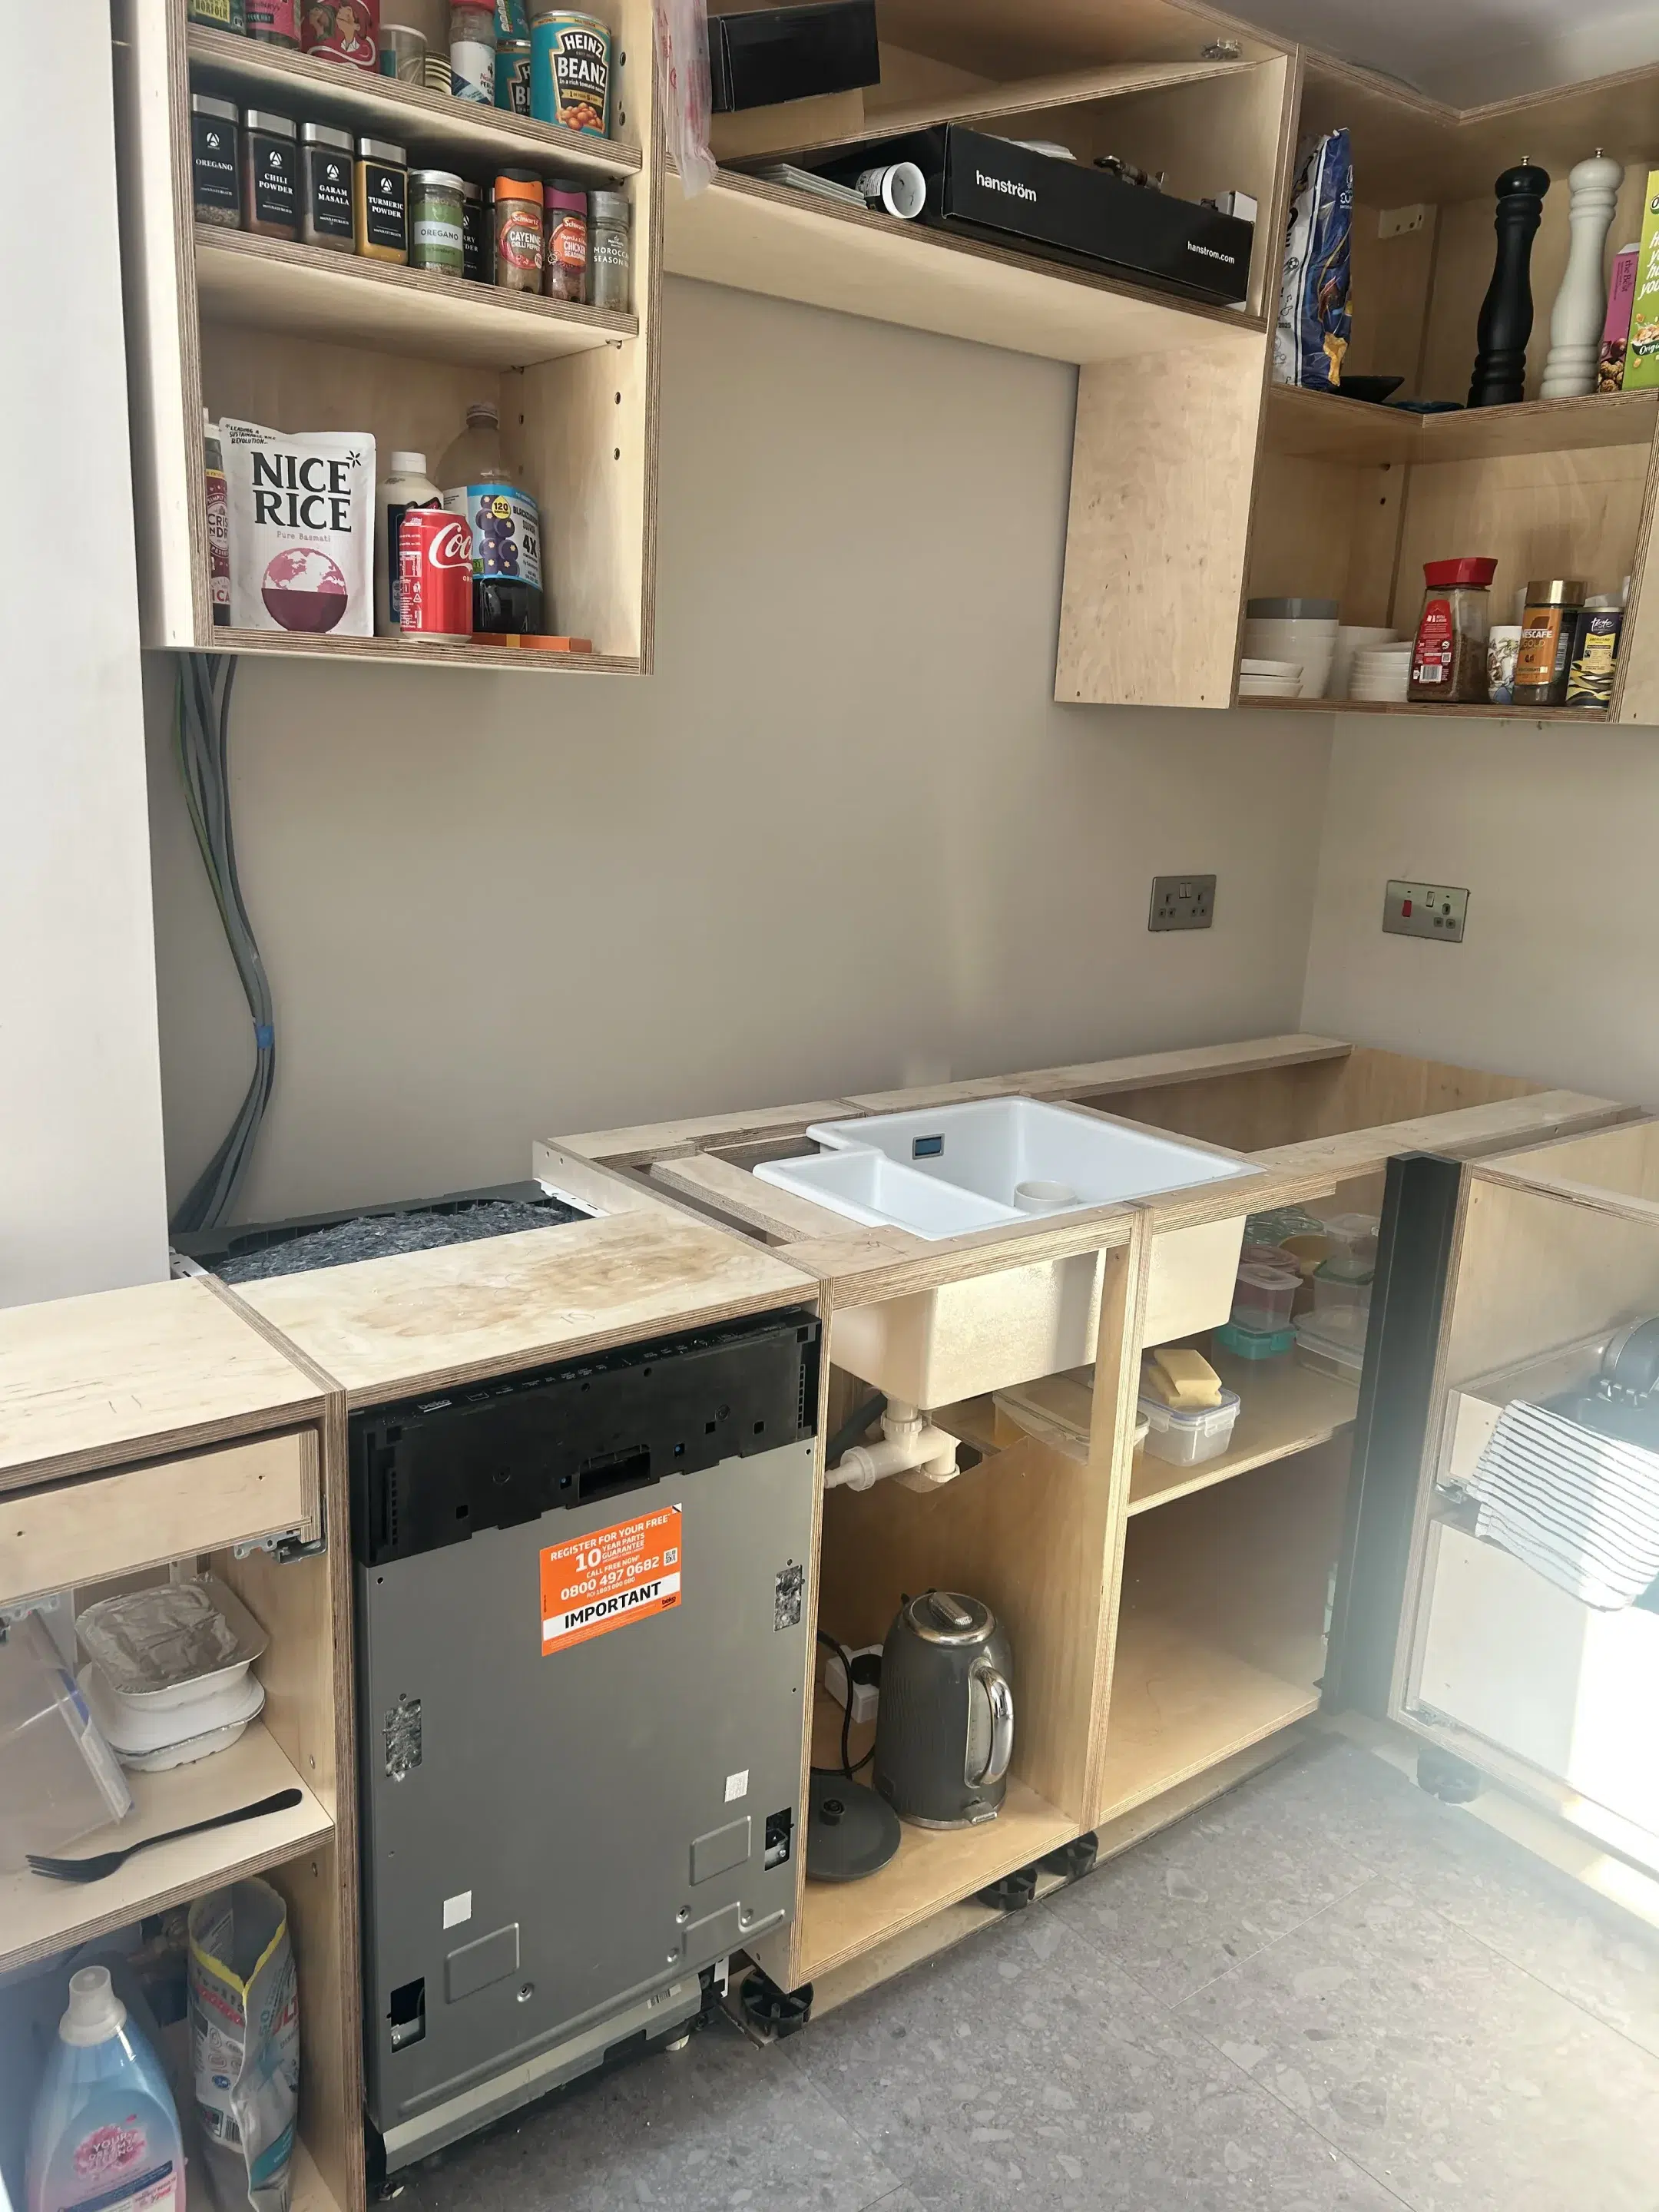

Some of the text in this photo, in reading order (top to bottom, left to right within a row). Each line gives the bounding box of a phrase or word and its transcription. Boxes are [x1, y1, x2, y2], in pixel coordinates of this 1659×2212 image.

[564, 34, 603, 58] HEINZ
[558, 57, 606, 87] BEANZ
[579, 81, 595, 90] tomato
[195, 158, 233, 171] OREGANO
[264, 173, 287, 184] CHILI
[975, 170, 1037, 202] hanström
[259, 180, 293, 195] POWDER
[319, 184, 348, 197] GARAM
[318, 193, 350, 206] MASALA
[368, 196, 404, 210] TURMERIC
[372, 205, 402, 219] POWDER
[420, 229, 459, 240] OREGANO
[510, 230, 541, 247] CAYENNE
[564, 240, 586, 256] CHICKEN
[1187, 240, 1235, 264] hanstrom.com
[250, 452, 352, 495] NICE
[252, 489, 353, 533] RICE
[494, 502, 508, 512] 120
[276, 530, 331, 542] Pure Basmati
[1591, 617, 1614, 631] taste
[1523, 639, 1545, 647] GOLD
[417, 1399, 451, 1410] beko
[550, 1538, 597, 1561] REGISTER
[598, 1532, 618, 1545] FOR
[619, 1522, 644, 1538] YOUR
[601, 1532, 645, 1552] YEAR PARTS
[601, 1539, 645, 1560] GUARANTEE
[575, 1548, 601, 1572] 10
[586, 1568, 603, 1578] CALL
[604, 1561, 621, 1572] FREE
[561, 1555, 660, 1601] 0800 497 0682
[565, 1581, 661, 1629] IMPORTANT
[661, 1595, 676, 1606] beko
